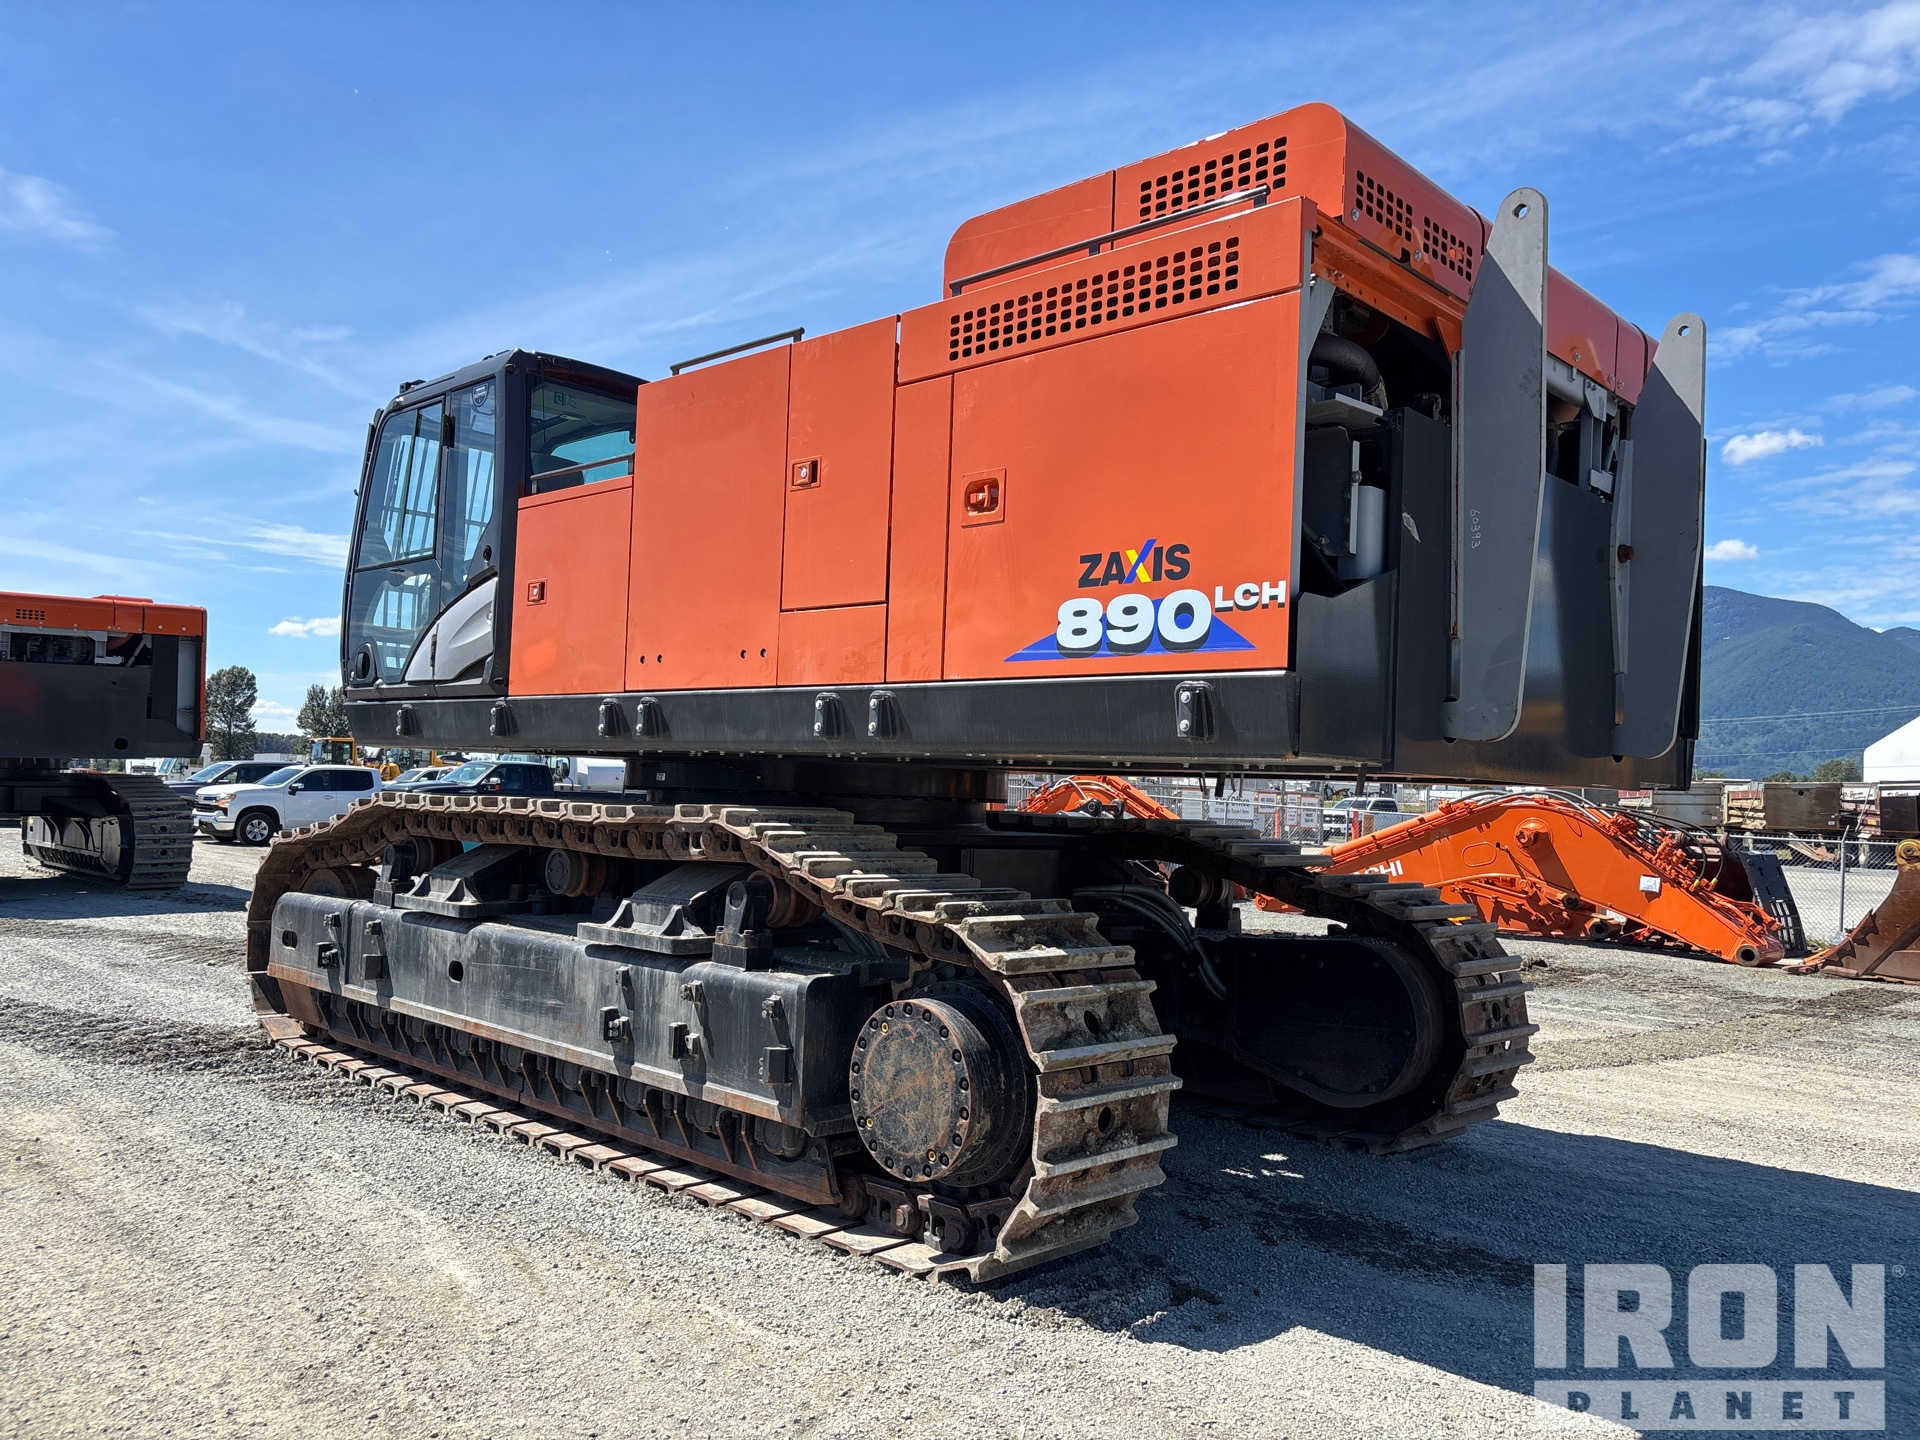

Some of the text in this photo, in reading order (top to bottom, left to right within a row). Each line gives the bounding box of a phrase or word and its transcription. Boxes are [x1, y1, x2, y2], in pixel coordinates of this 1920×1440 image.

[1469, 509, 1481, 548] 60393
[1078, 538, 1191, 588] ZAXIS
[1056, 580, 1287, 659] 890 LCH
